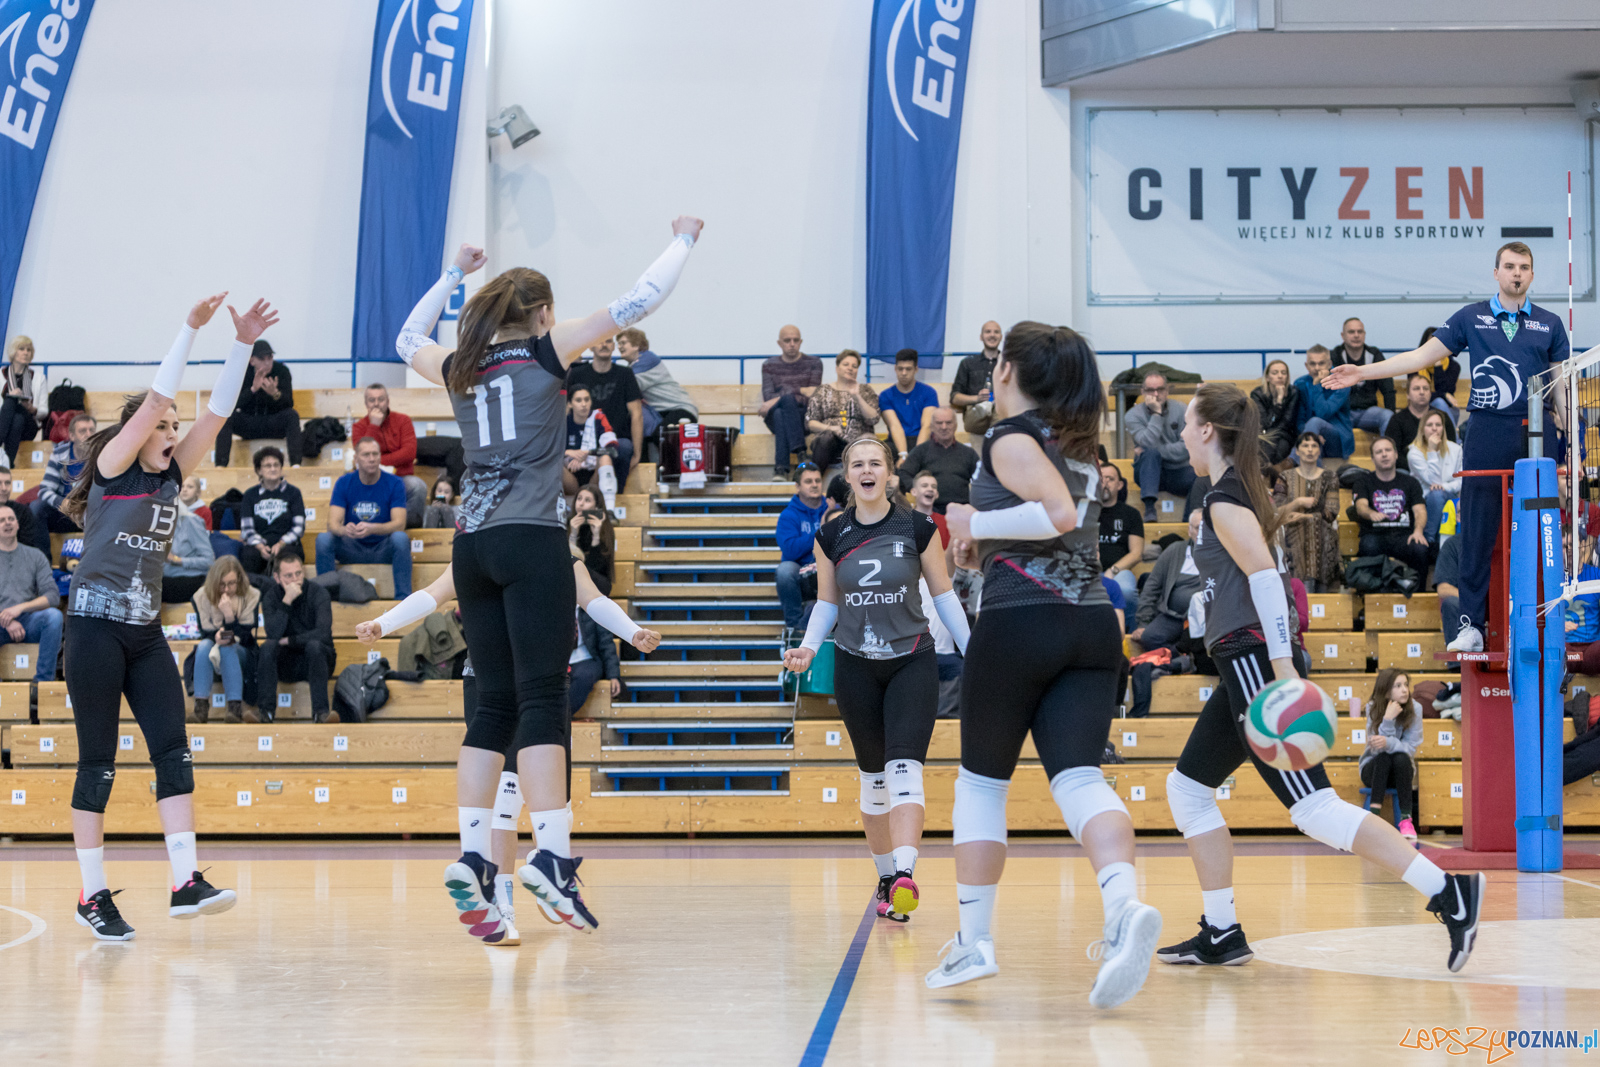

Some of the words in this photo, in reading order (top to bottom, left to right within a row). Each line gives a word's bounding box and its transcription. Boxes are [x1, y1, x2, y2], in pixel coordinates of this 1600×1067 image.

[407, 0, 463, 112] En
[1127, 166, 1485, 221] CITYZEN
[1236, 226, 1297, 242] WIĘCEJ
[1306, 224, 1334, 239] NIŻ
[1342, 226, 1385, 239] KLUB
[1394, 226, 1486, 239] SPORTOWY
[465, 374, 517, 448] 11
[148, 503, 177, 535] 13
[857, 558, 882, 588] 2
[1462, 653, 1489, 661] Senoh
[122, 737, 131, 745] 15
[1441, 733, 1450, 741] 16
[193, 739, 202, 747] 14
[1454, 785, 1462, 793] 16
[15, 792, 23, 800] 16
[240, 793, 249, 801] 13
